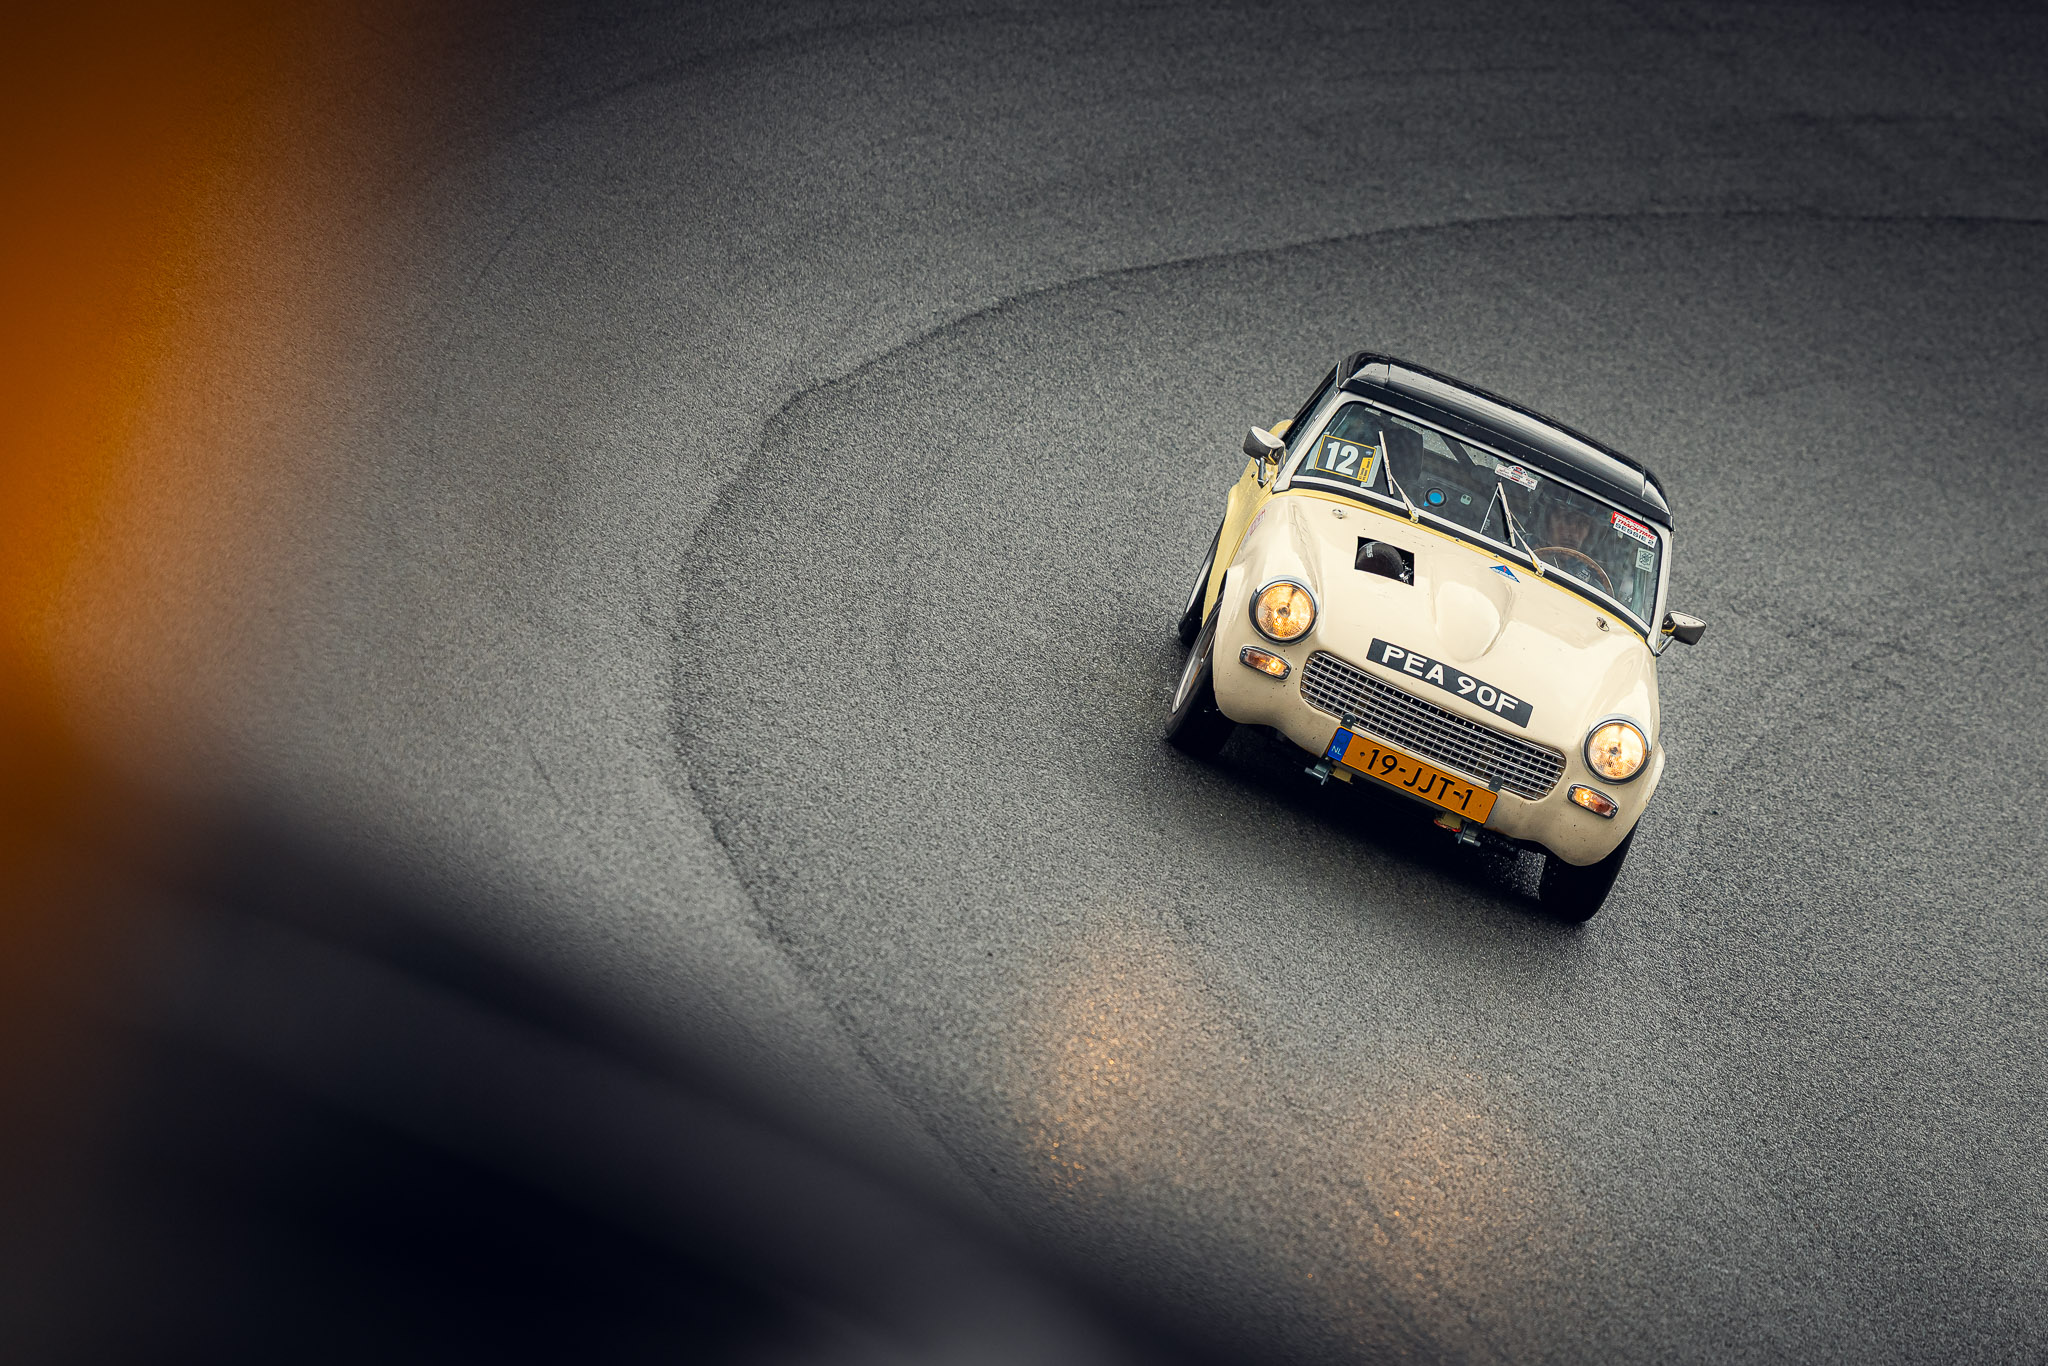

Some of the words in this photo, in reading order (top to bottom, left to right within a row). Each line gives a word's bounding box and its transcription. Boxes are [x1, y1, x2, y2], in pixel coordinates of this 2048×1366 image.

[1325, 441, 1359, 476] 12
[1614, 522, 1646, 543] SESSIE
[1617, 519, 1655, 540] TRACKTIME
[1381, 645, 1444, 685] PEA
[1457, 676, 1519, 713] 90F
[1330, 745, 1342, 756] NL
[1367, 749, 1474, 811] 19-JJT-1
